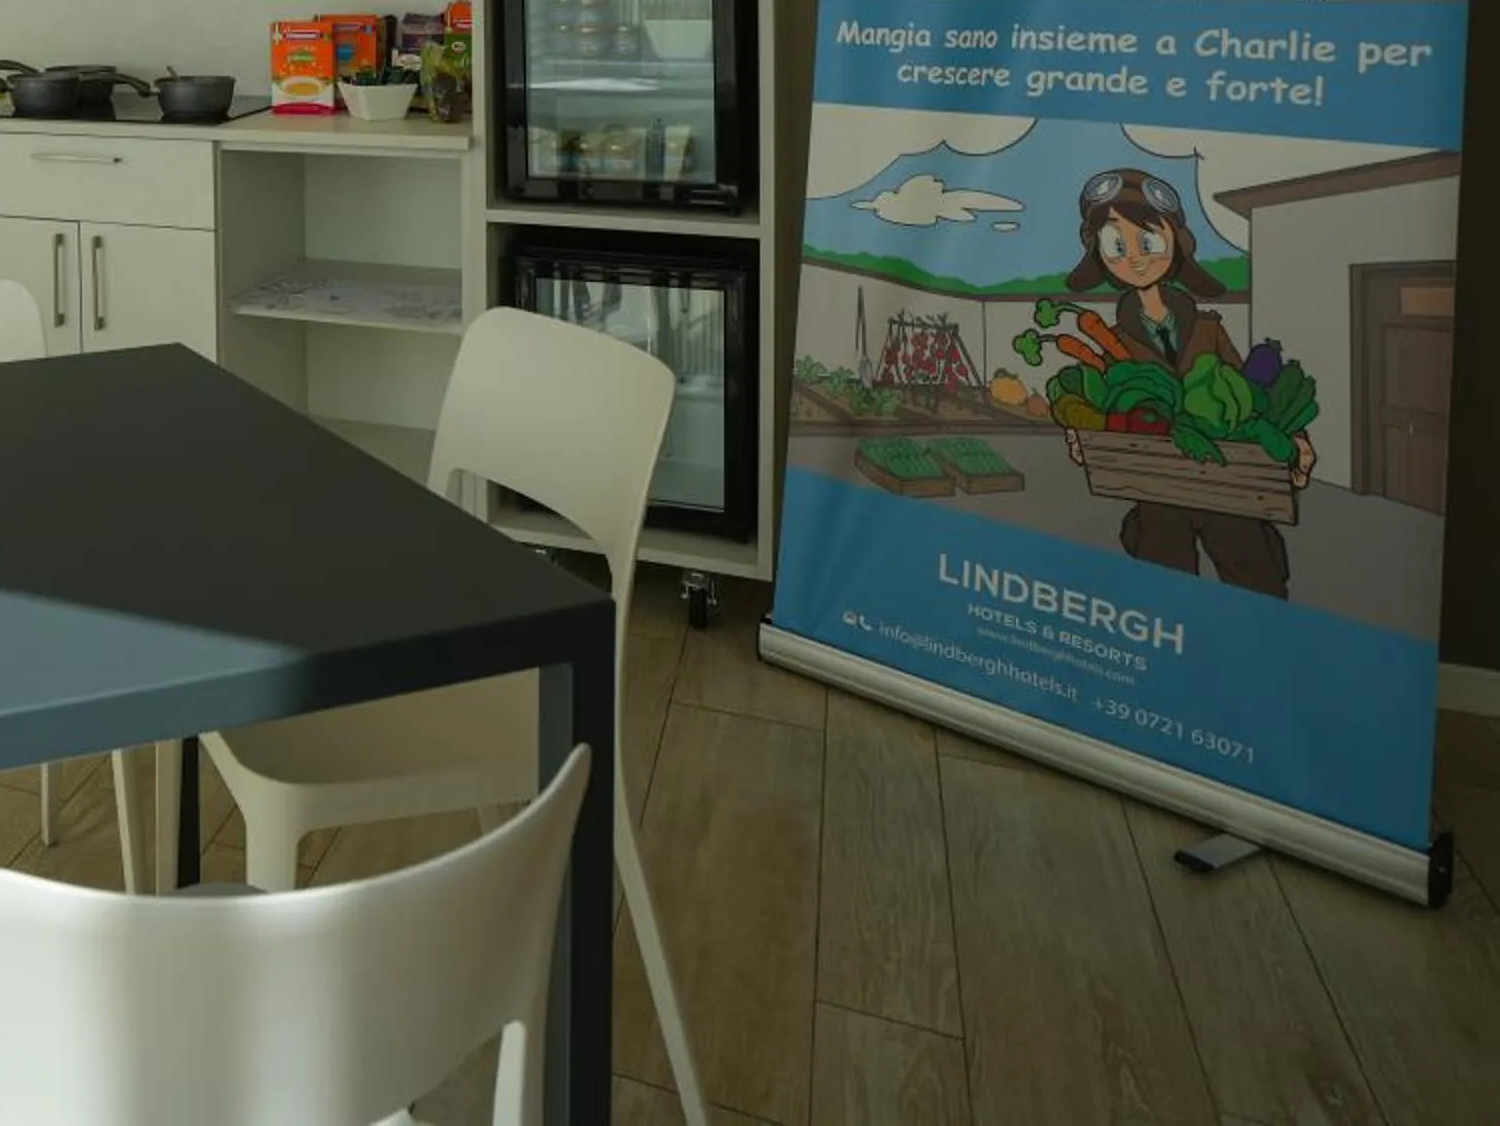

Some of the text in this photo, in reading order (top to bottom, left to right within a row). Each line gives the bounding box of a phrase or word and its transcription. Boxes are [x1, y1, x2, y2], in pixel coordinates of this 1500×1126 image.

[835, 21, 1433, 74] Mangia sano insieme a Charlie per
[898, 63, 1325, 107] crescere grande e forte!
[938, 553, 1187, 656] LINDBERGH
[967, 602, 1038, 636] HOTELS
[1058, 630, 1149, 672] RESORTS
[879, 620, 1256, 764] info@lindberghhotels.it +39 0721 63071
